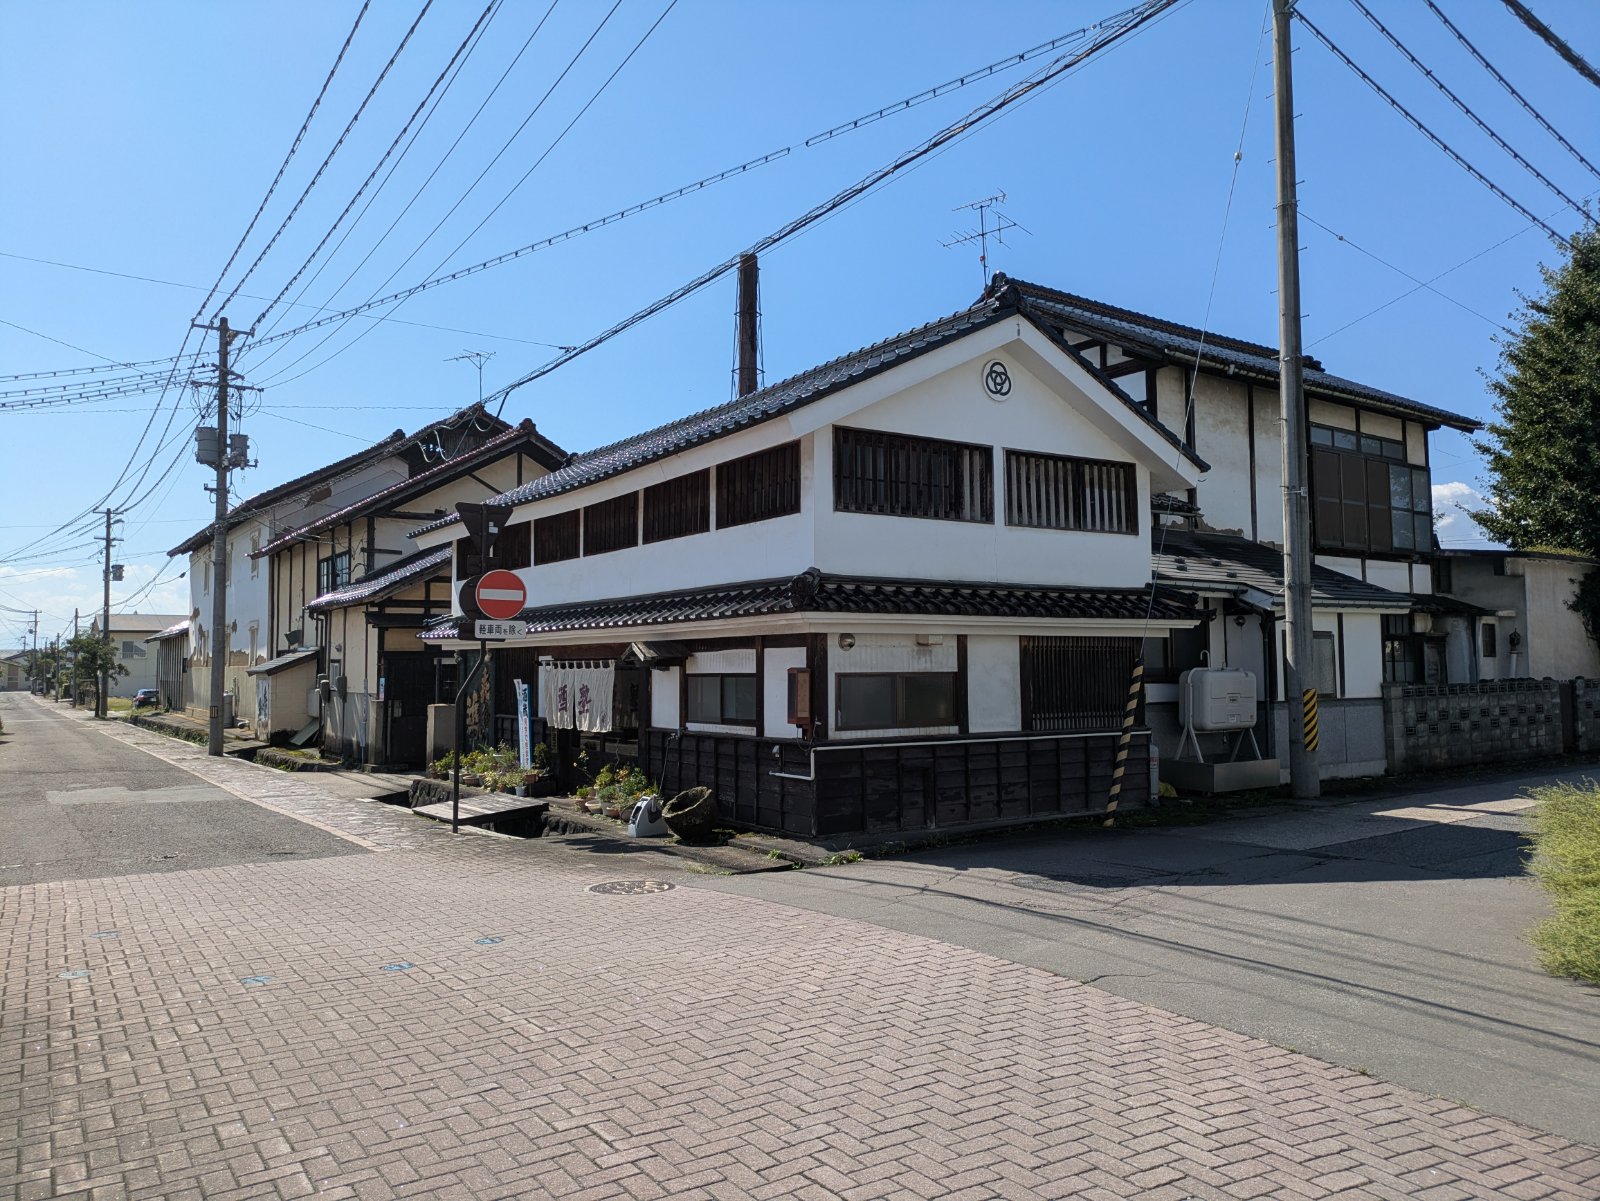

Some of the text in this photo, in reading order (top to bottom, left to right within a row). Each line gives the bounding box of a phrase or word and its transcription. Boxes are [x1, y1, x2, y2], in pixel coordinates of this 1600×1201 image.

[479, 624, 523, 635] 軽車両を除く
